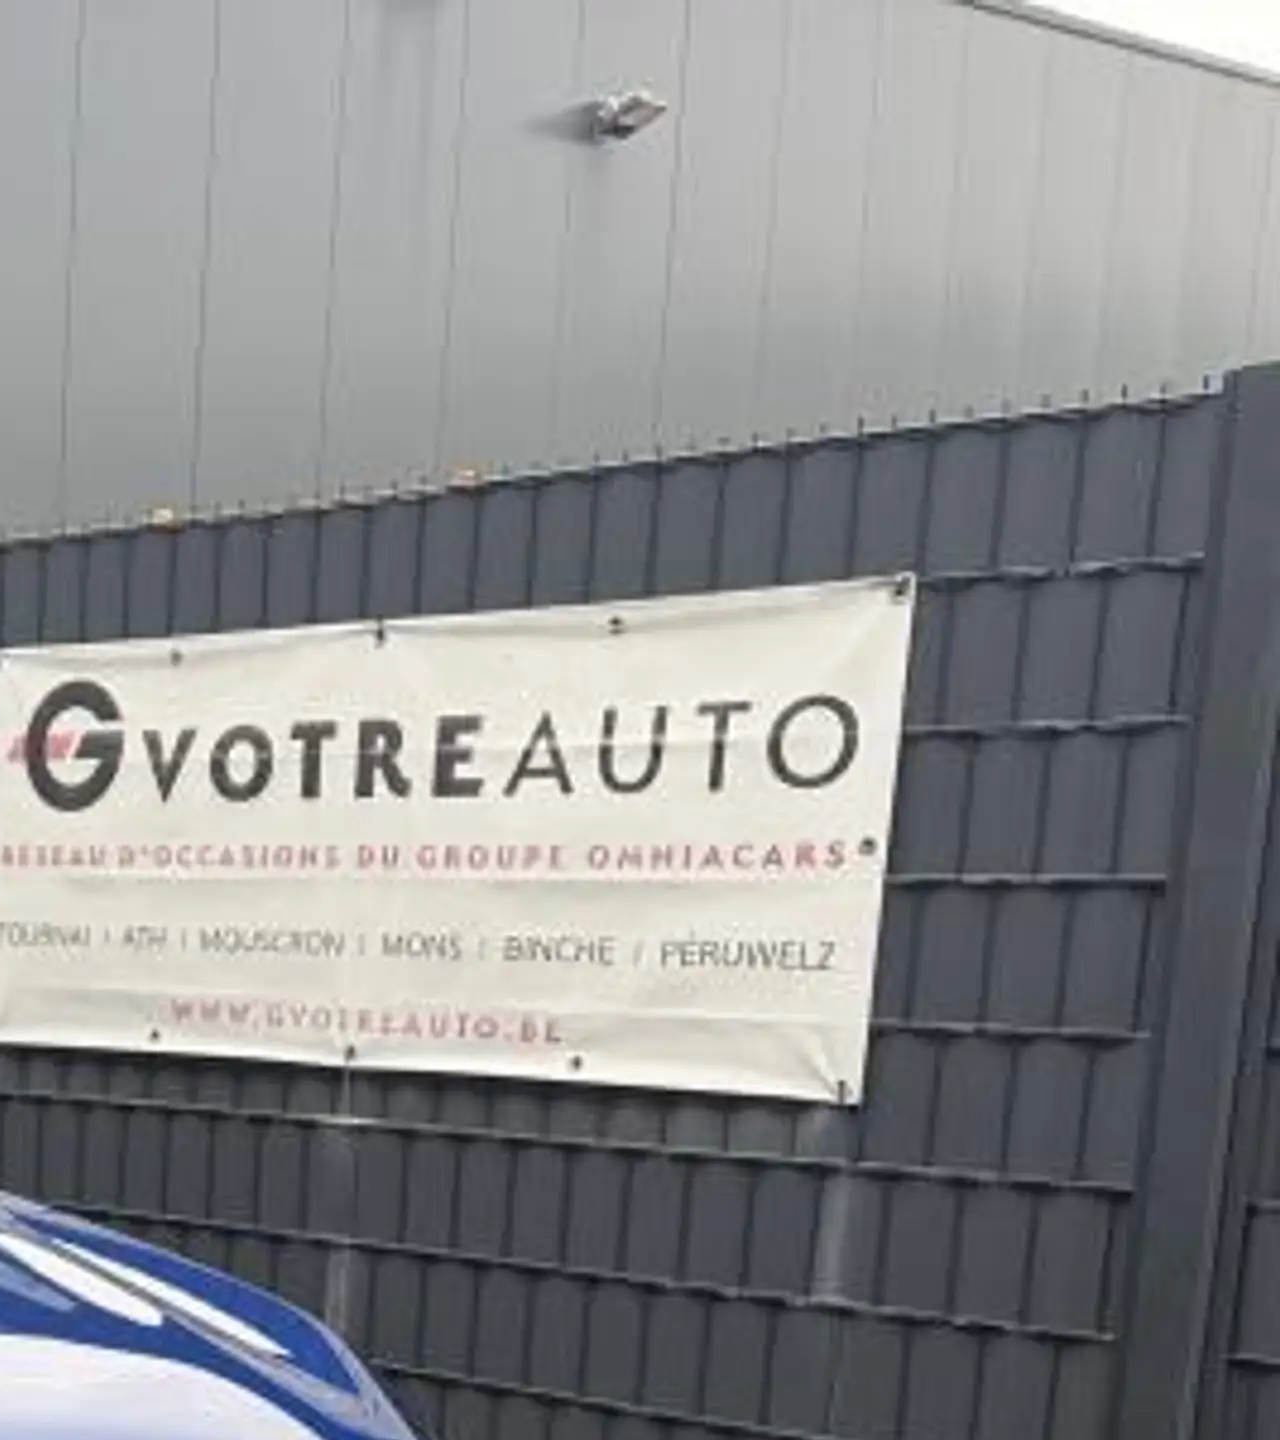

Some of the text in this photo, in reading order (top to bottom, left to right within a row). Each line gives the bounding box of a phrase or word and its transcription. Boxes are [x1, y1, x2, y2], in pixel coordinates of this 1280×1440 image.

[357, 845, 400, 869] DU
[415, 844, 564, 870] GROUPE
[588, 839, 846, 871] OMNIACARS
[381, 931, 462, 961] MONS
[502, 935, 616, 967] BINCHE
